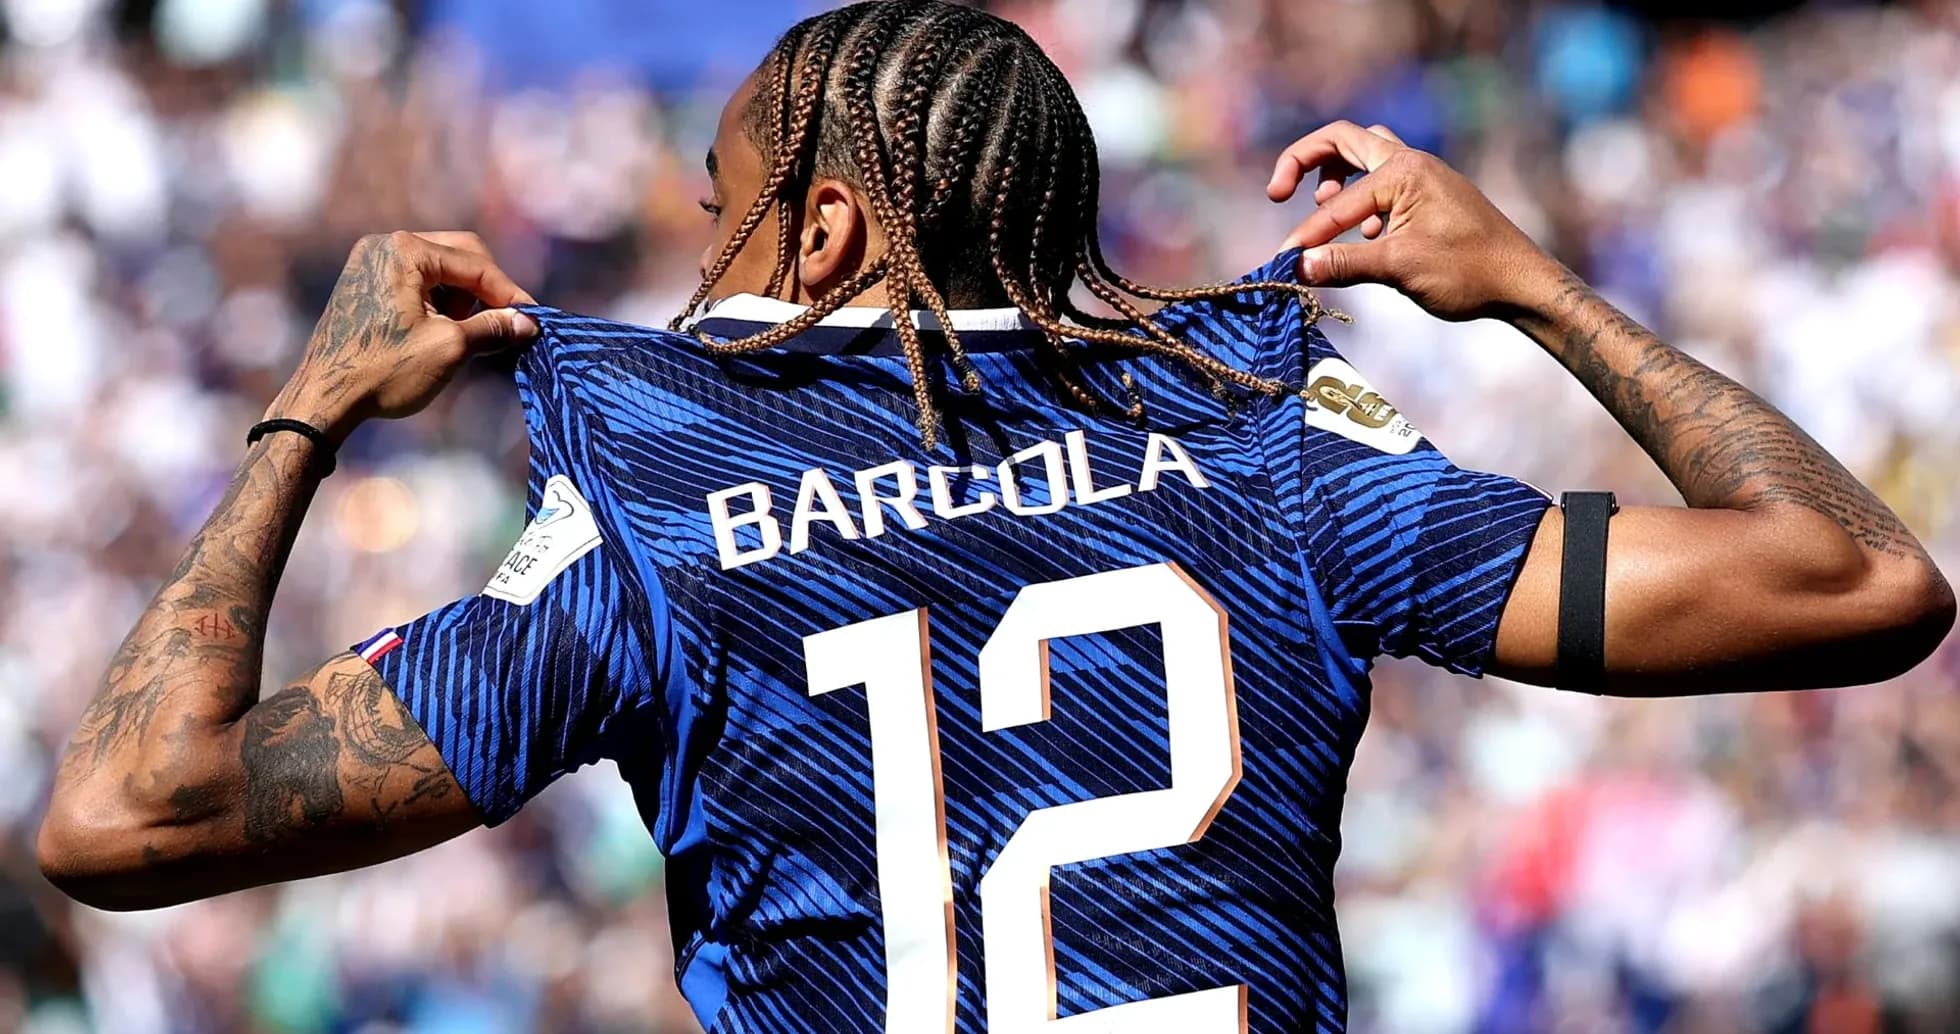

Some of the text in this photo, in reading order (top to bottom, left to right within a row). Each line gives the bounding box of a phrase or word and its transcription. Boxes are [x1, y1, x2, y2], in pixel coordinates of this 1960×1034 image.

[504, 551, 538, 576] ACE
[706, 429, 1211, 570] BARCOLA
[802, 560, 1243, 1034] 12
